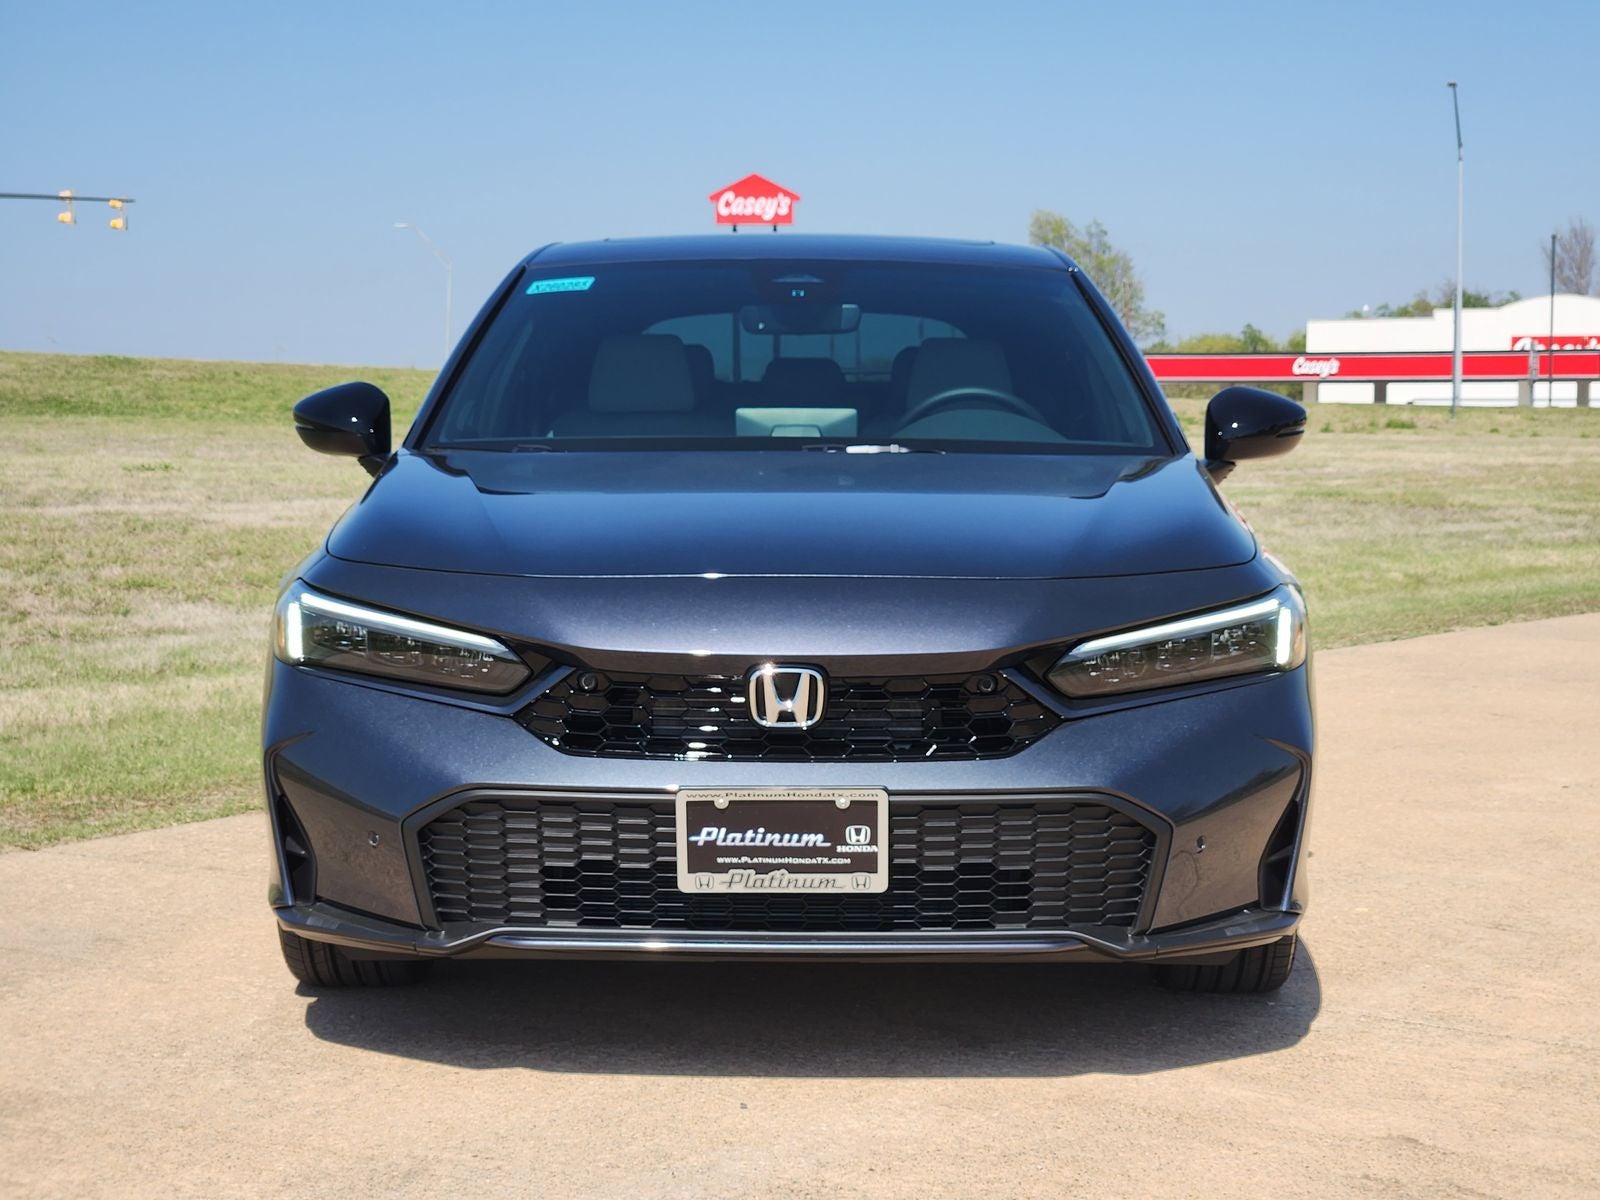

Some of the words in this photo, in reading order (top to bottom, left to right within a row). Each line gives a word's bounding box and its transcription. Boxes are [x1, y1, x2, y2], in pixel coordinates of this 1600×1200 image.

[717, 190, 792, 221] Casey's
[688, 826, 832, 847] Platinum
[836, 845, 878, 853] HONDA
[719, 872, 846, 889] Platinum
